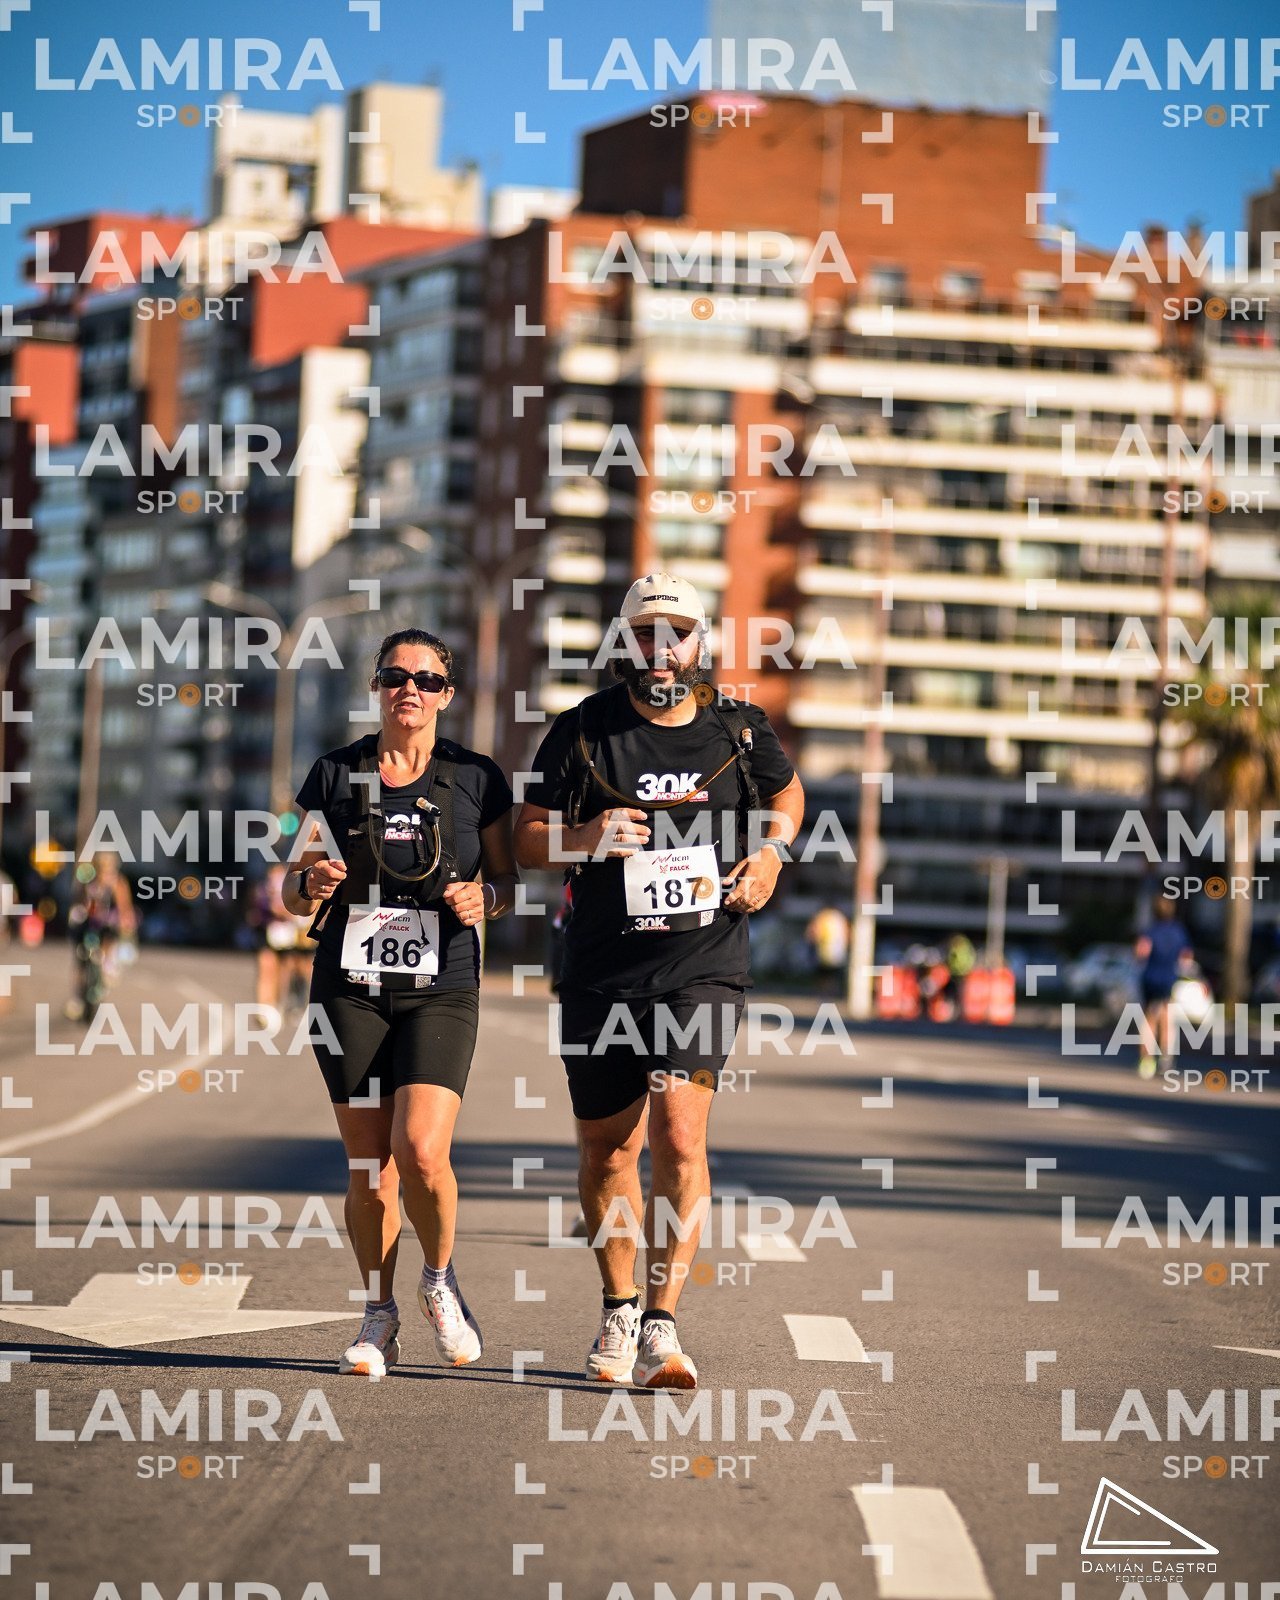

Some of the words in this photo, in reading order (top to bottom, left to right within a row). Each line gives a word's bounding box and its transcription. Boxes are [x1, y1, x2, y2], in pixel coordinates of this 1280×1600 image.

[636, 773, 702, 801] 30K
[643, 877, 703, 909] 187
[634, 916, 666, 931] 30K
[361, 936, 421, 967] 186
[346, 971, 380, 984] 30K
